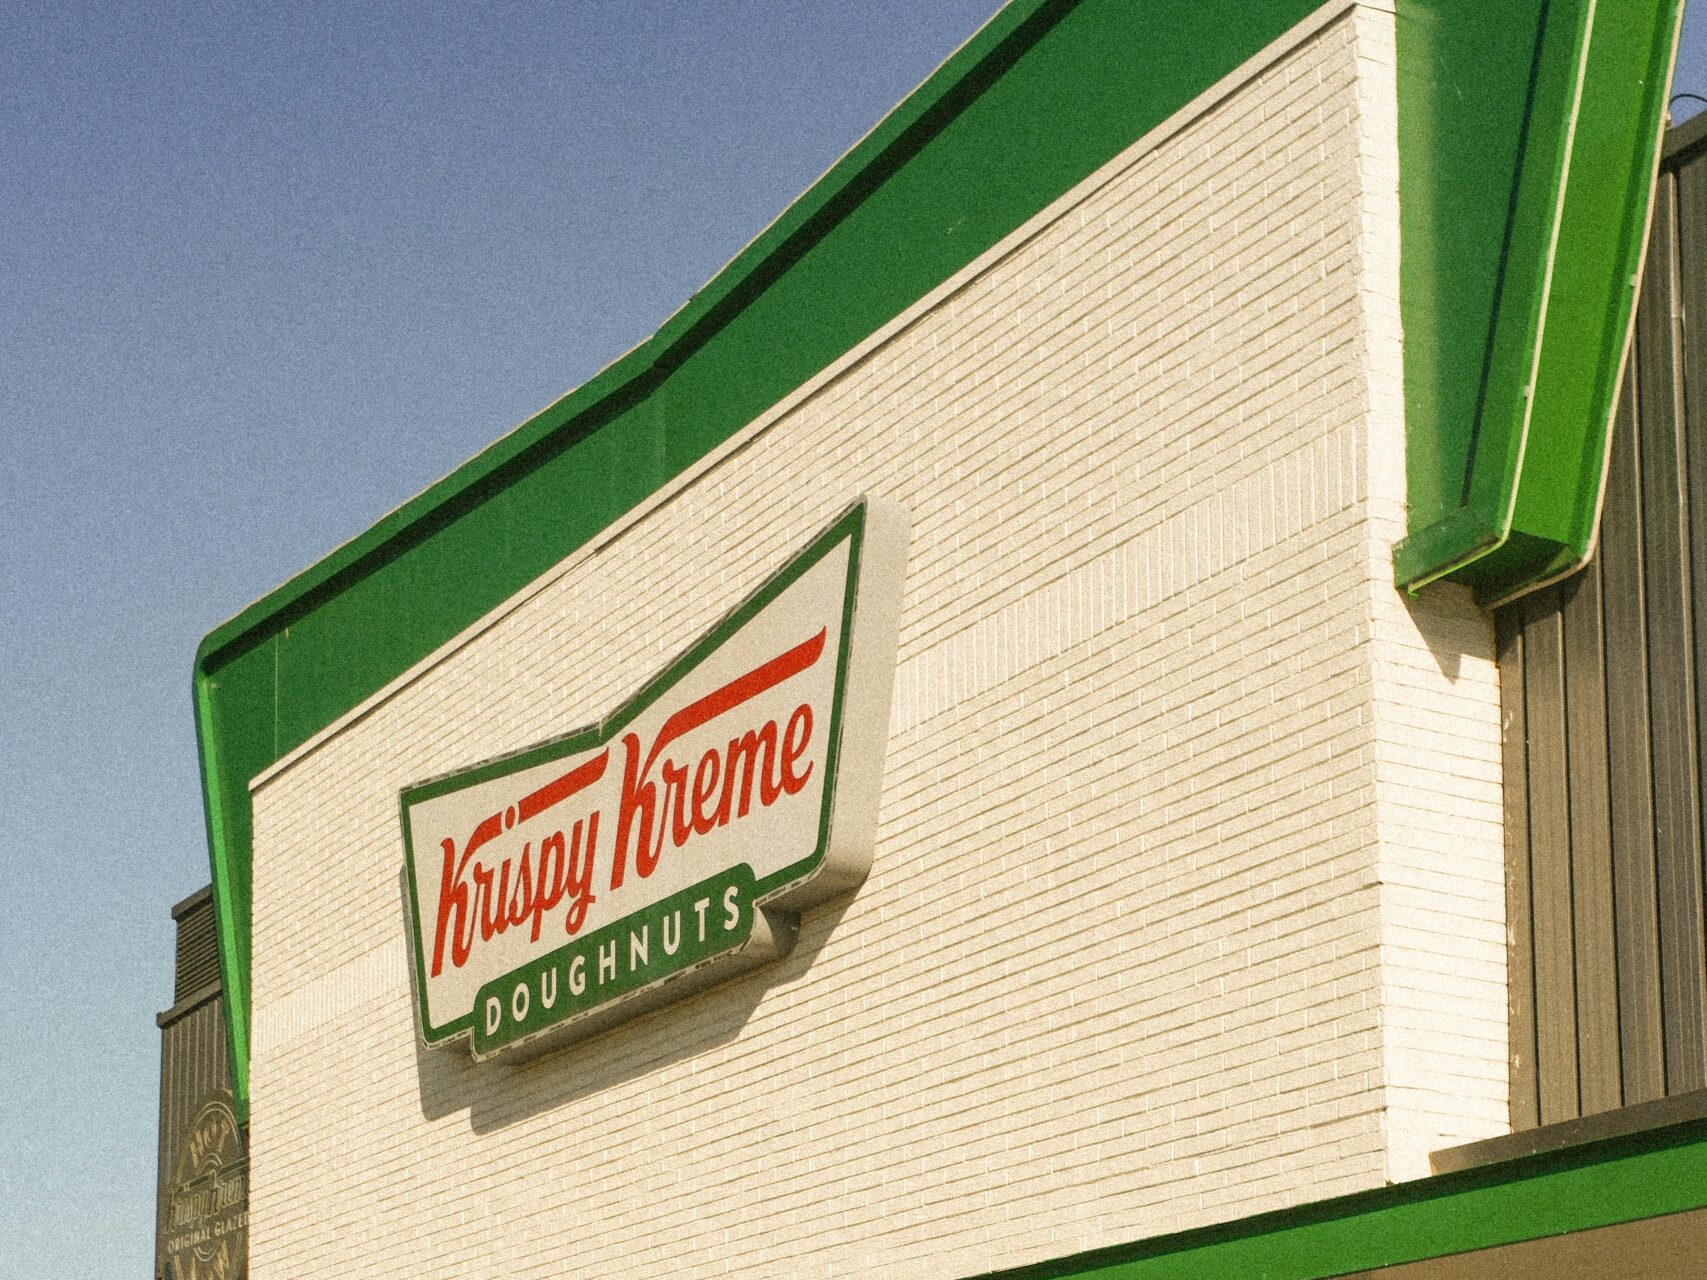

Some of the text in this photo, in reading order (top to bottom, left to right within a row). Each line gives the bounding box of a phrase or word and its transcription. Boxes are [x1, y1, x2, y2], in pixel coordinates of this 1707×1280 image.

[431, 625, 827, 978] Krispy Kreme
[486, 886, 740, 1036] DOUGHNUTS
[167, 1227, 211, 1254] ORIGINAL
